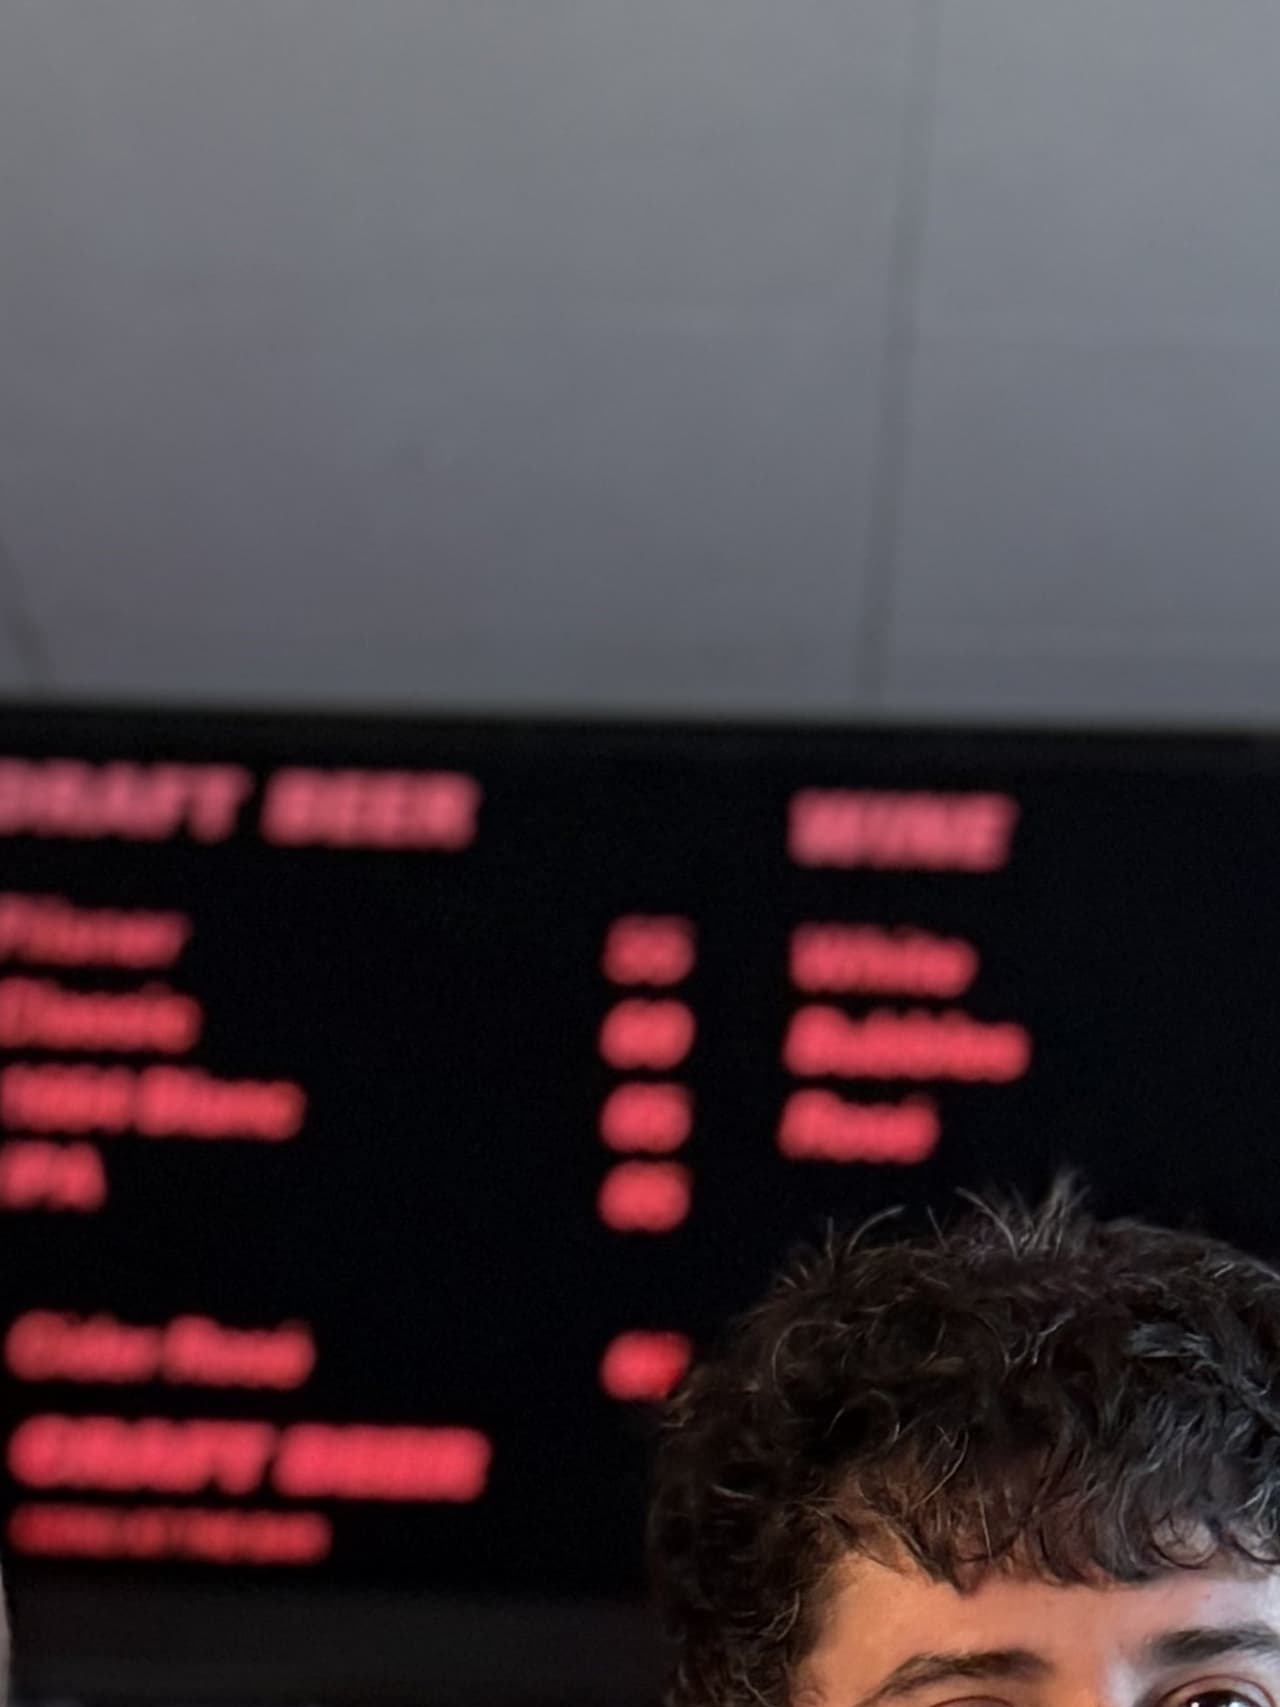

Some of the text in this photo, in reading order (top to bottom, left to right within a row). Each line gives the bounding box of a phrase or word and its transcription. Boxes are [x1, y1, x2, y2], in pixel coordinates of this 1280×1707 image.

[265, 772, 474, 844] BEER
[792, 795, 1010, 867] WINE
[278, 1427, 486, 1497] BEER
